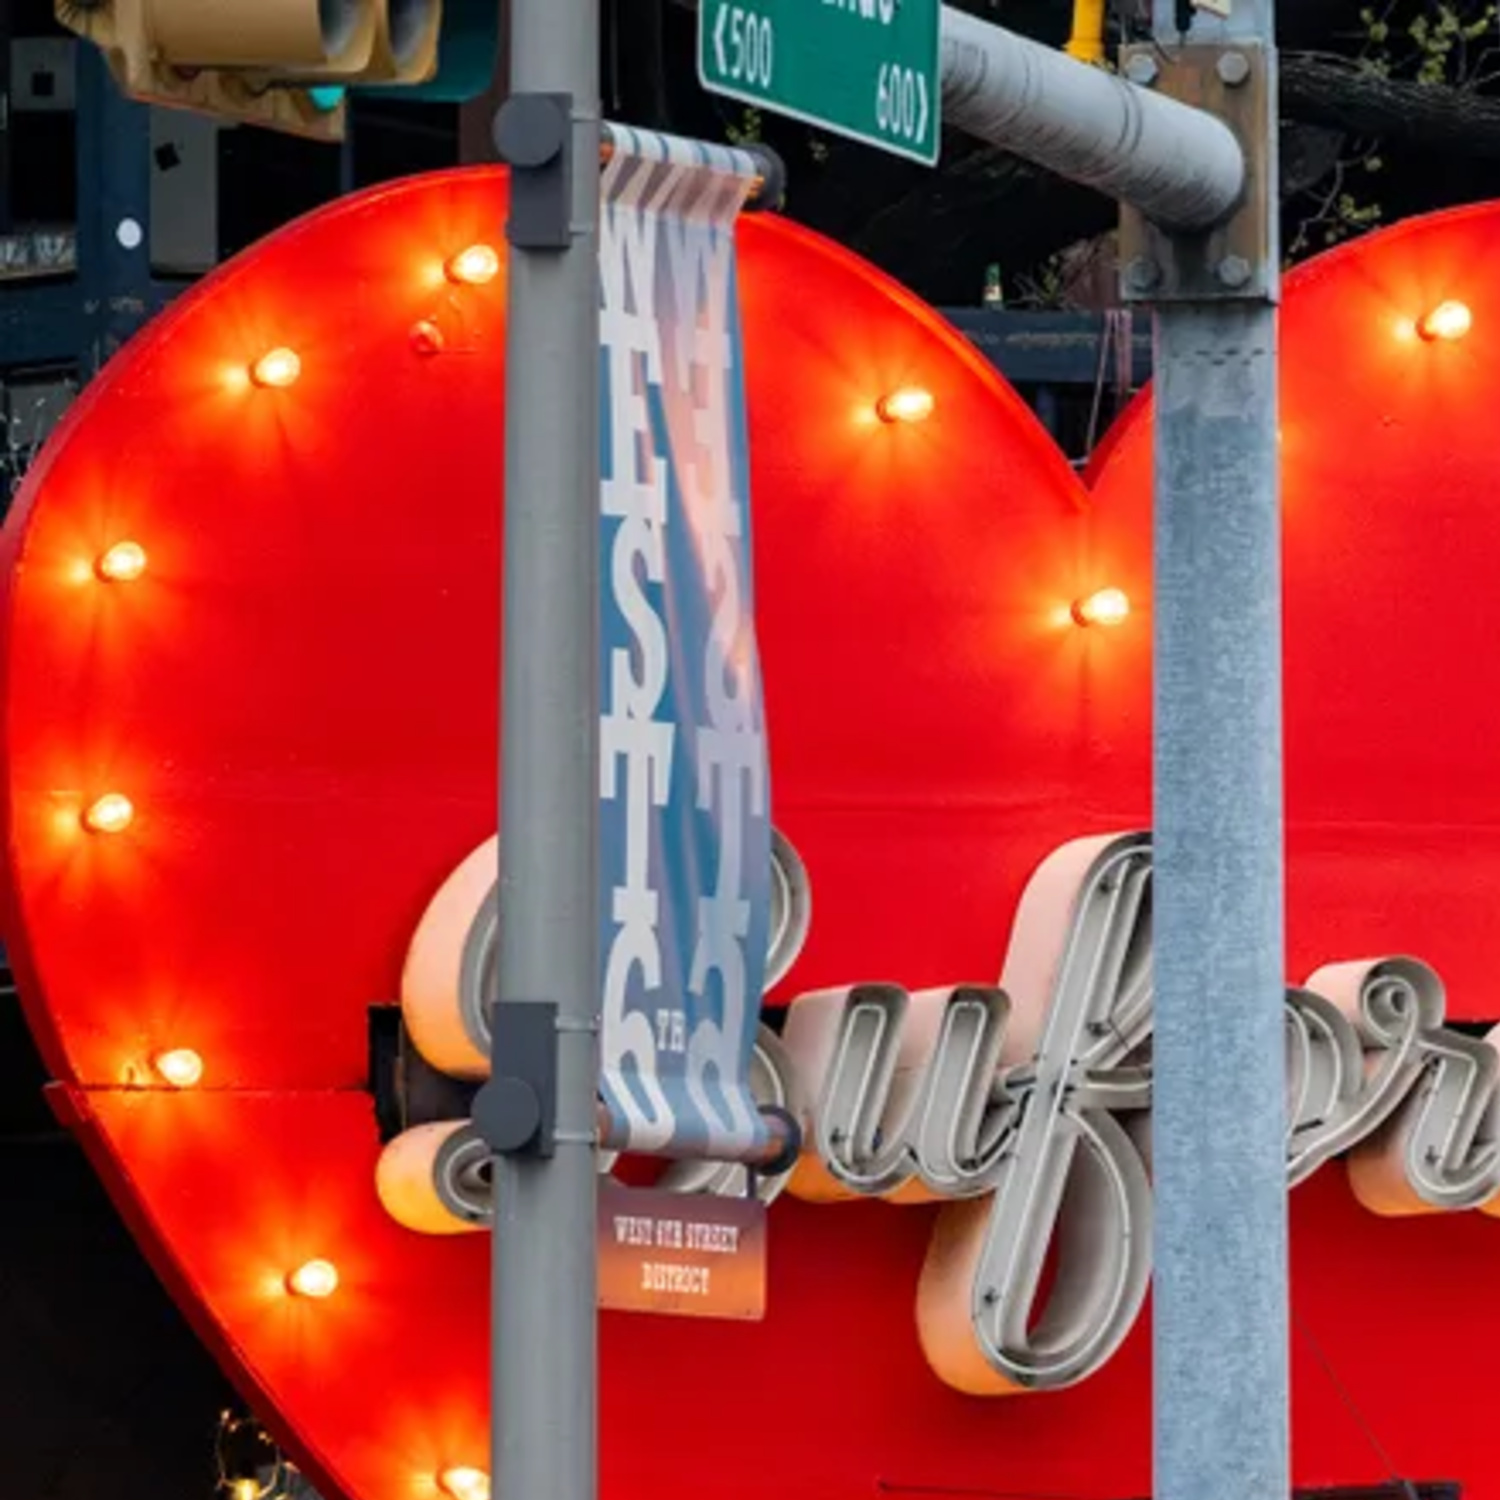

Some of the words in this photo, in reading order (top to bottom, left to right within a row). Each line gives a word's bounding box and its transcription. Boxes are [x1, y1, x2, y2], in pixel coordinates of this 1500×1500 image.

[613, 1216, 652, 1246] WEST
[685, 1222, 738, 1253] STREET
[641, 1262, 709, 1295] DISTRICT
